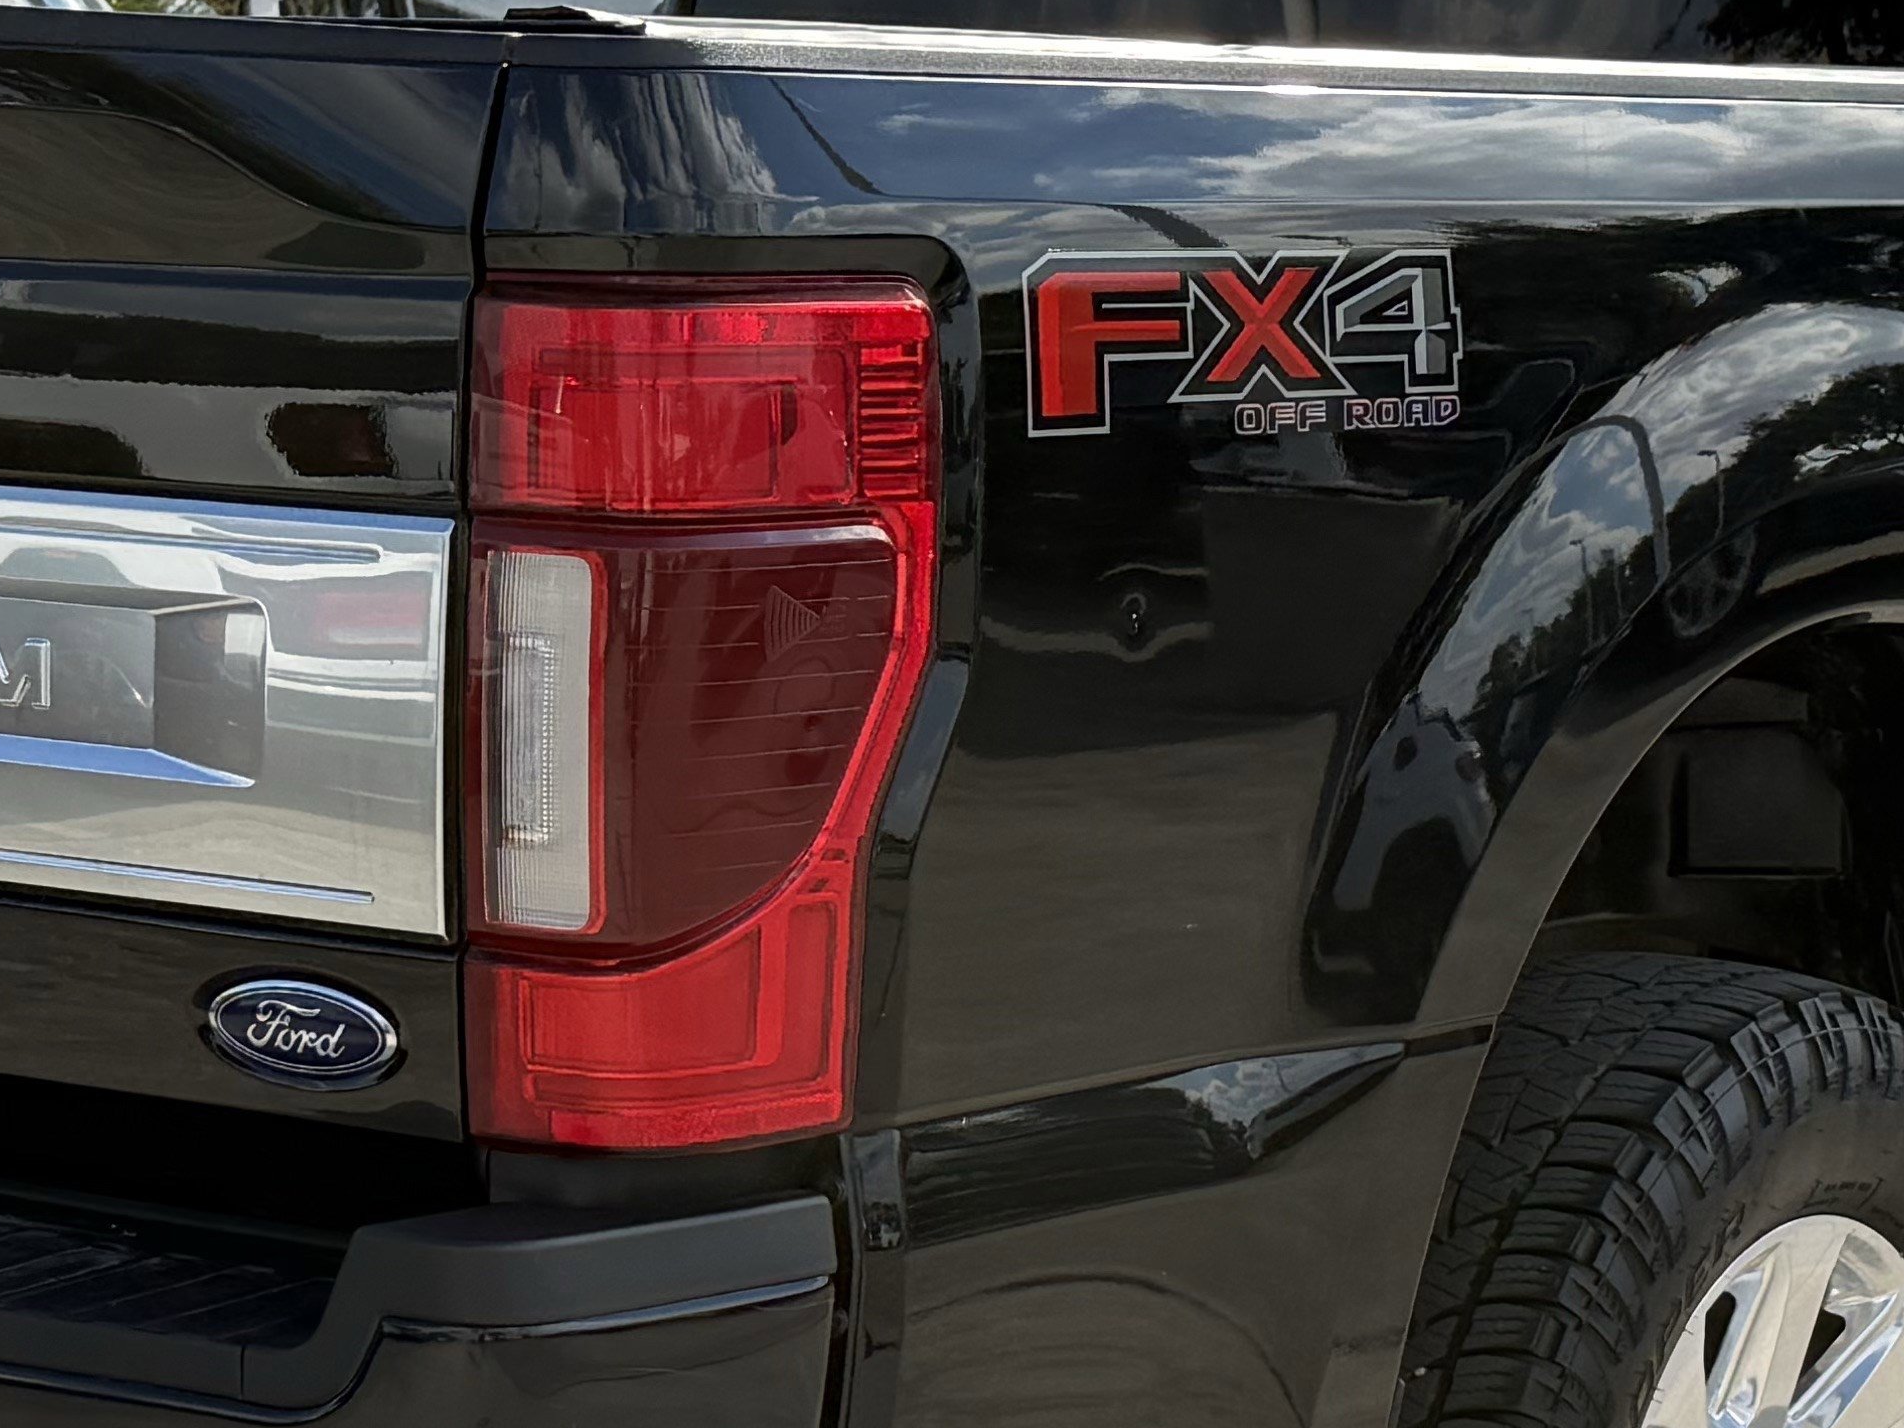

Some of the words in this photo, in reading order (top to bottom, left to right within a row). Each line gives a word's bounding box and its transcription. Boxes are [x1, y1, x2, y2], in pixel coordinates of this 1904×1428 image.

[1022, 248, 1464, 438] FX4
[1234, 400, 1328, 435] OFF
[1343, 395, 1461, 431] ROAD
[246, 997, 346, 1062] Ford
